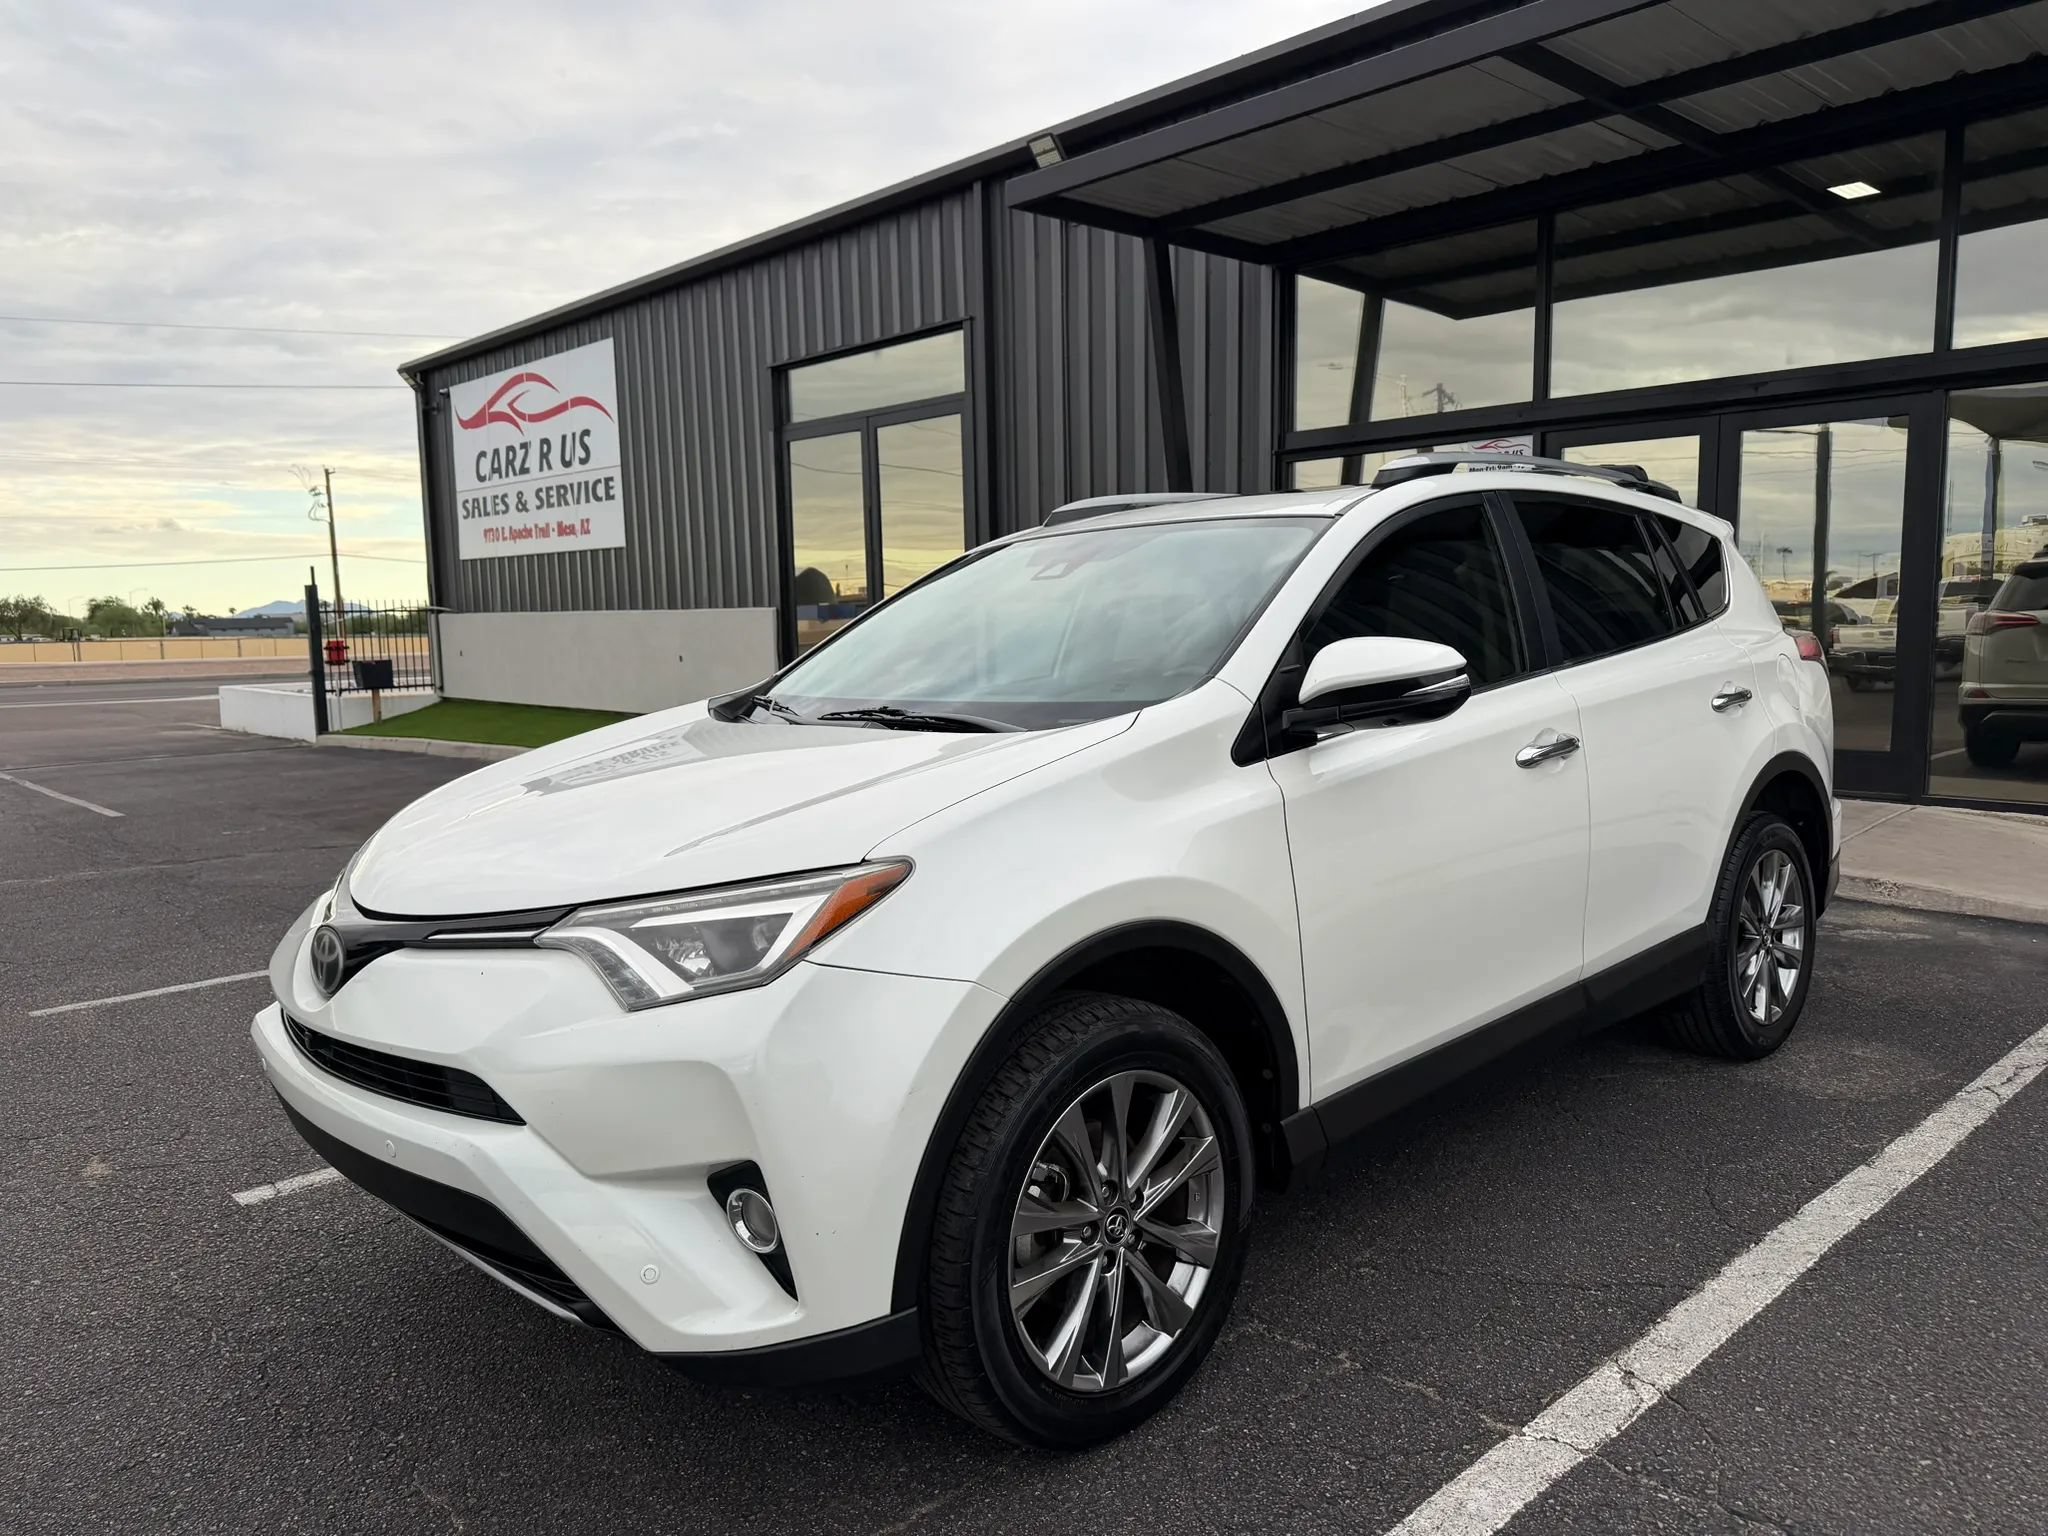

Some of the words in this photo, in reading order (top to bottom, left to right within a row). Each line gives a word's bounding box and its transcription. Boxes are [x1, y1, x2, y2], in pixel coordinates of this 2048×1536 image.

[539, 437, 553, 472] R
[560, 428, 591, 469] US
[461, 492, 510, 520] SALES
[515, 490, 530, 513] &
[535, 476, 616, 511] SERVICE
[509, 523, 533, 544] Apache
[580, 517, 591, 536] AZ
